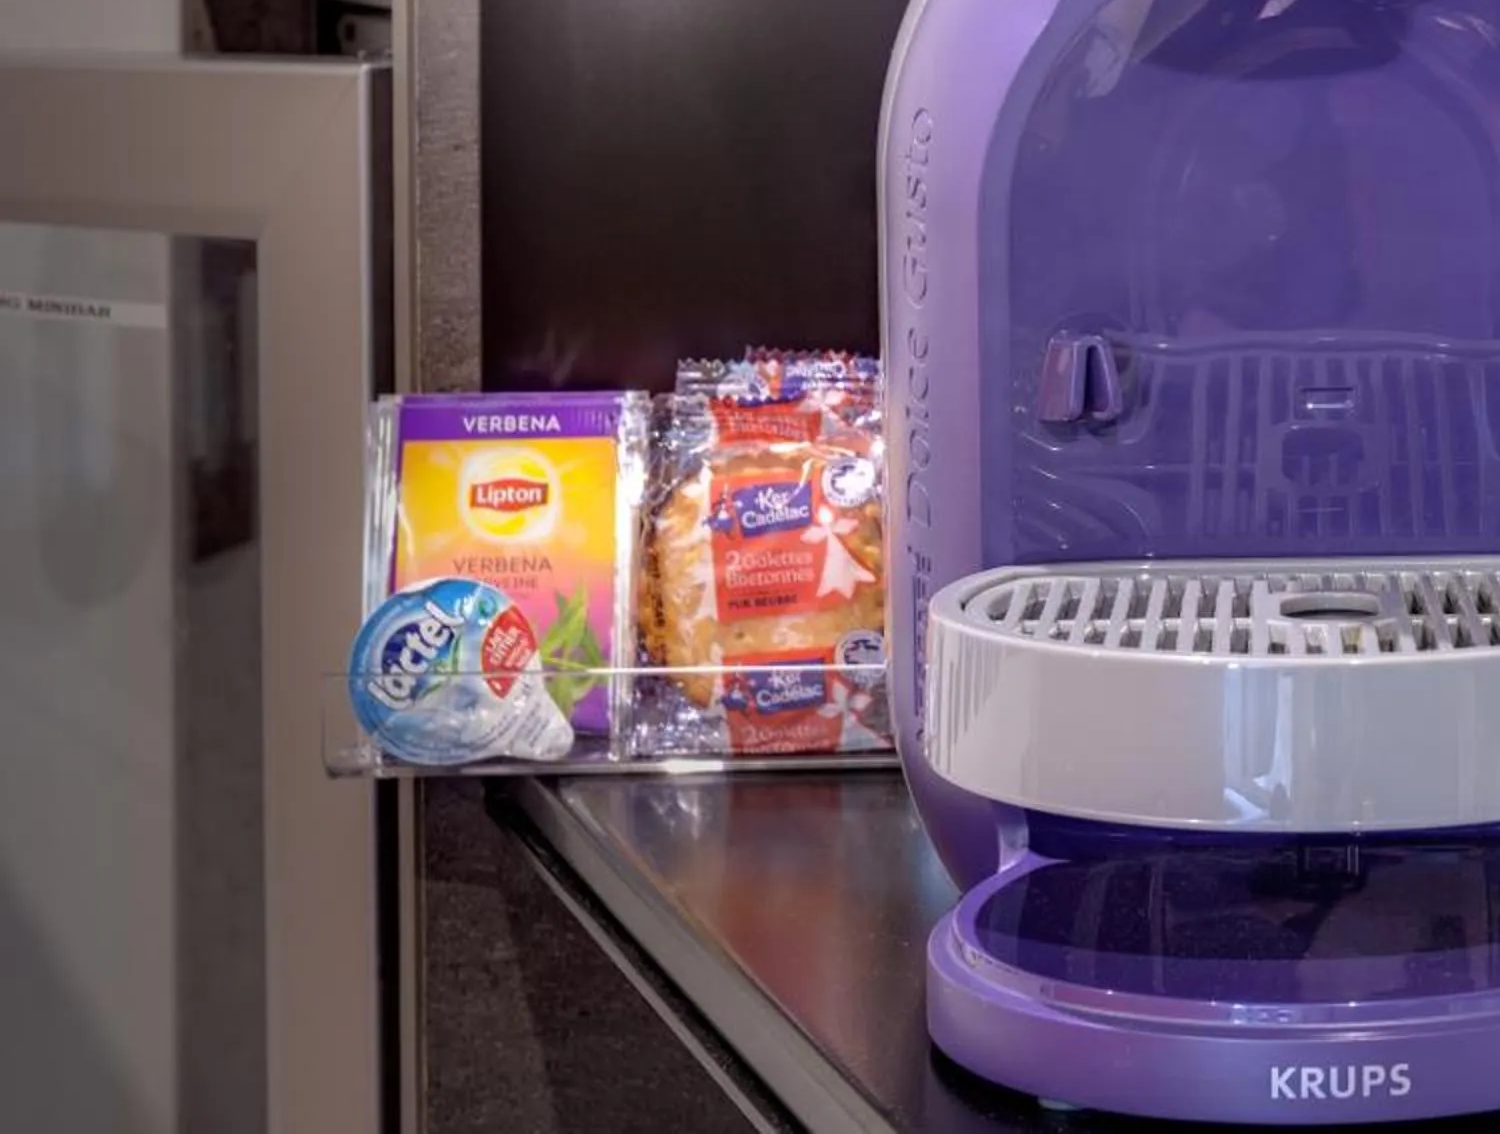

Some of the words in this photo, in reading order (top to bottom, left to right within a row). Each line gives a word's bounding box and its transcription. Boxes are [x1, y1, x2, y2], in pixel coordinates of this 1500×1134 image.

[463, 414, 561, 433] VERBENA
[476, 487, 542, 507] Lipton
[755, 487, 790, 510] Ker
[453, 556, 553, 574] VERBENA
[1271, 1063, 1412, 1099] KRUPS
